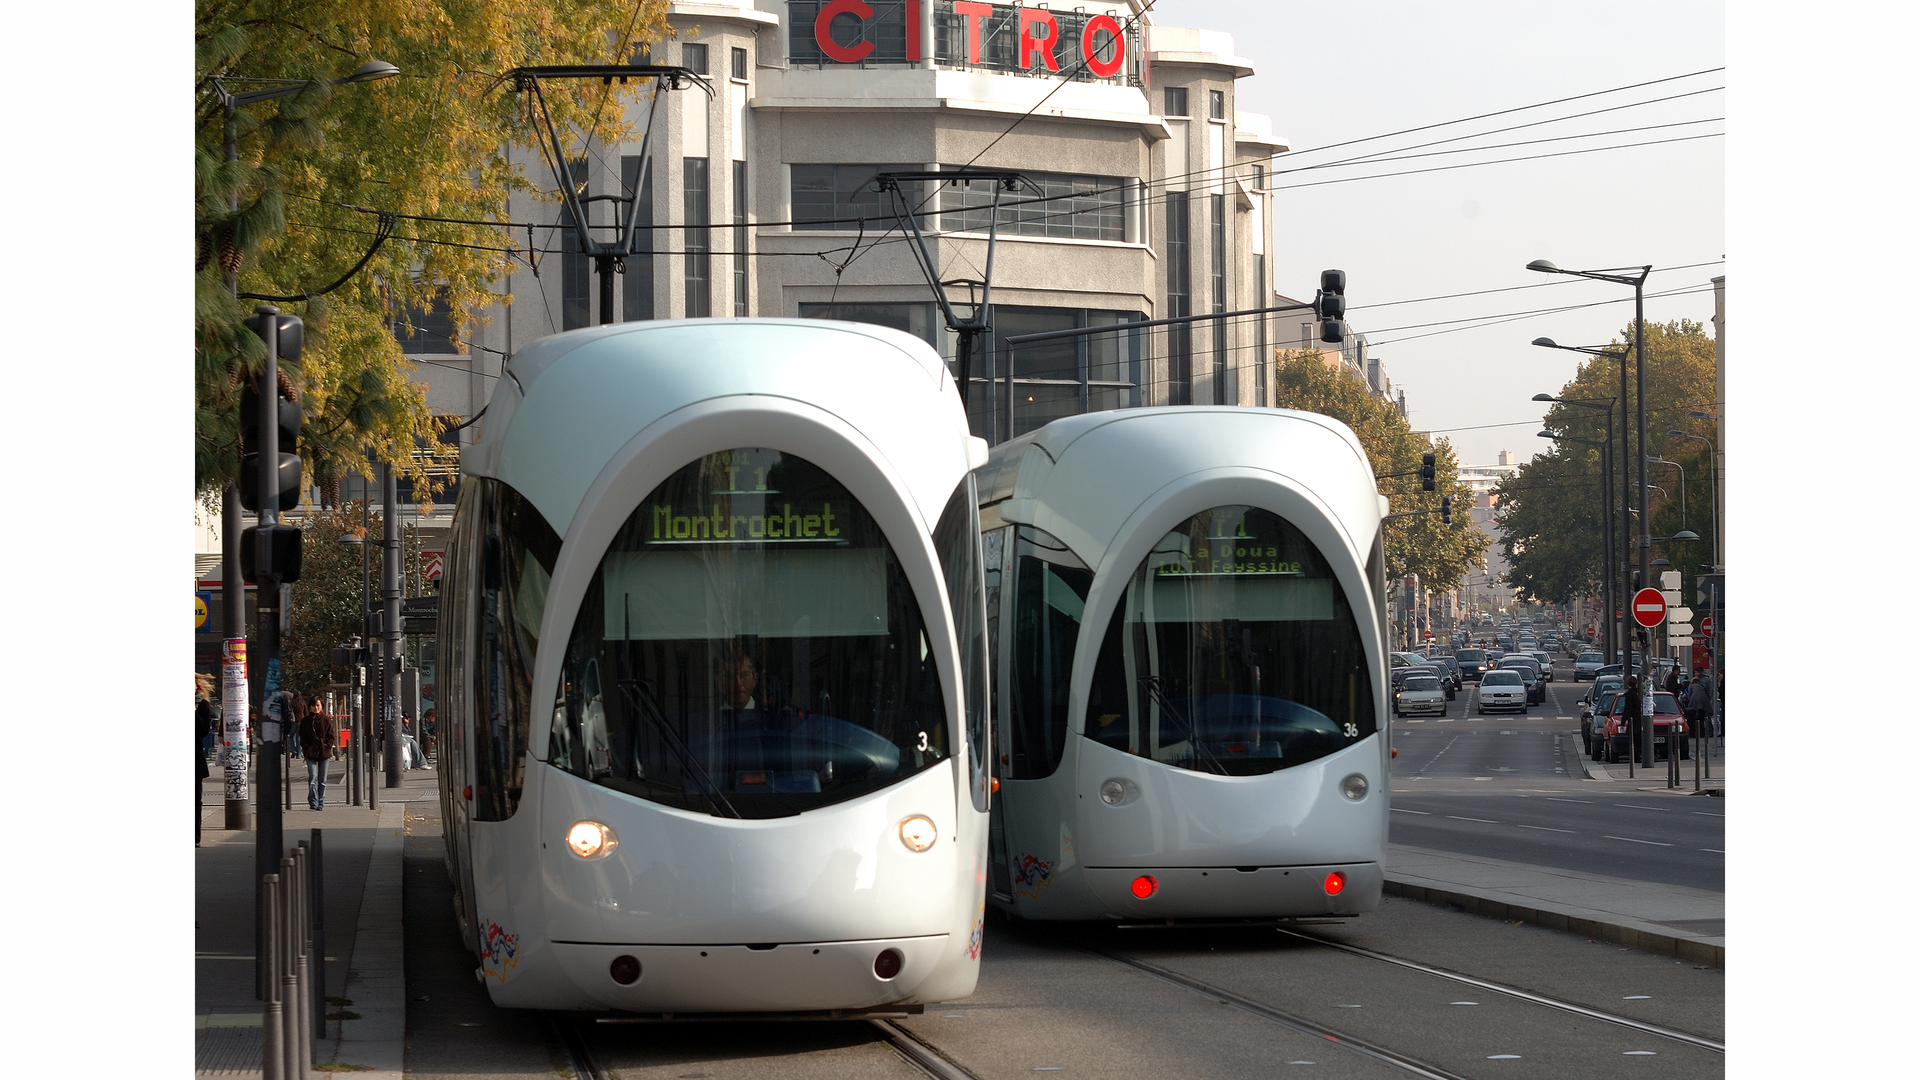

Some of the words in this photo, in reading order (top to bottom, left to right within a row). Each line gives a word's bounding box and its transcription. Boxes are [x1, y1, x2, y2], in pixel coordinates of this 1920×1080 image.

[653, 503, 840, 538] Montrochet
[1221, 544, 1278, 558] Doua
[1211, 559, 1301, 574] Feyssine
[1343, 722, 1359, 738] 36
[916, 731, 928, 752] 3
